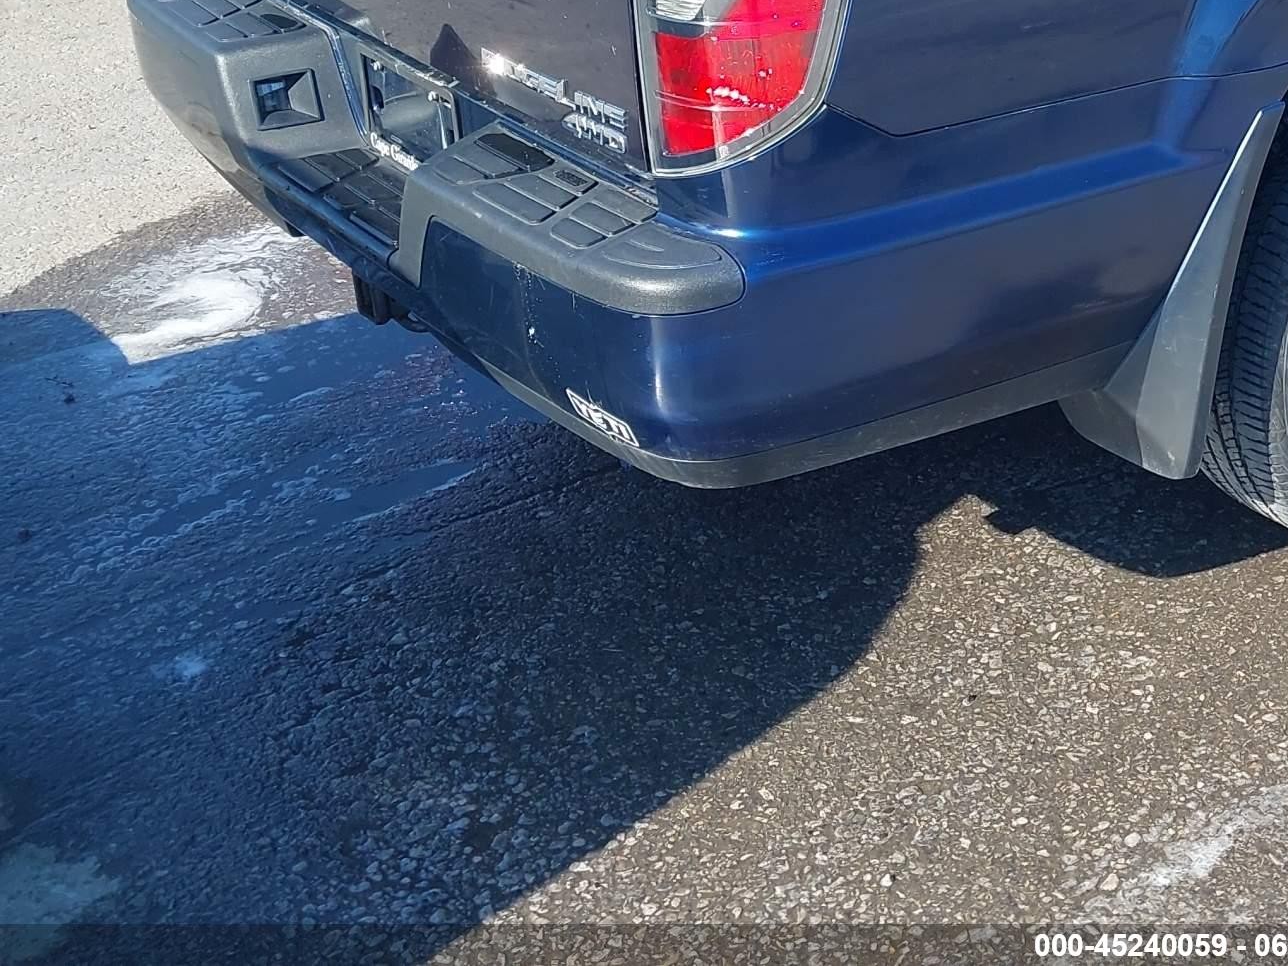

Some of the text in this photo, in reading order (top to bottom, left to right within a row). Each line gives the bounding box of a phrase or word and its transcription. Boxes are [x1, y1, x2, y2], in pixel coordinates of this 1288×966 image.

[480, 46, 629, 132] RDGELINE
[370, 132, 390, 157] Cape
[561, 111, 628, 154] 4WD
